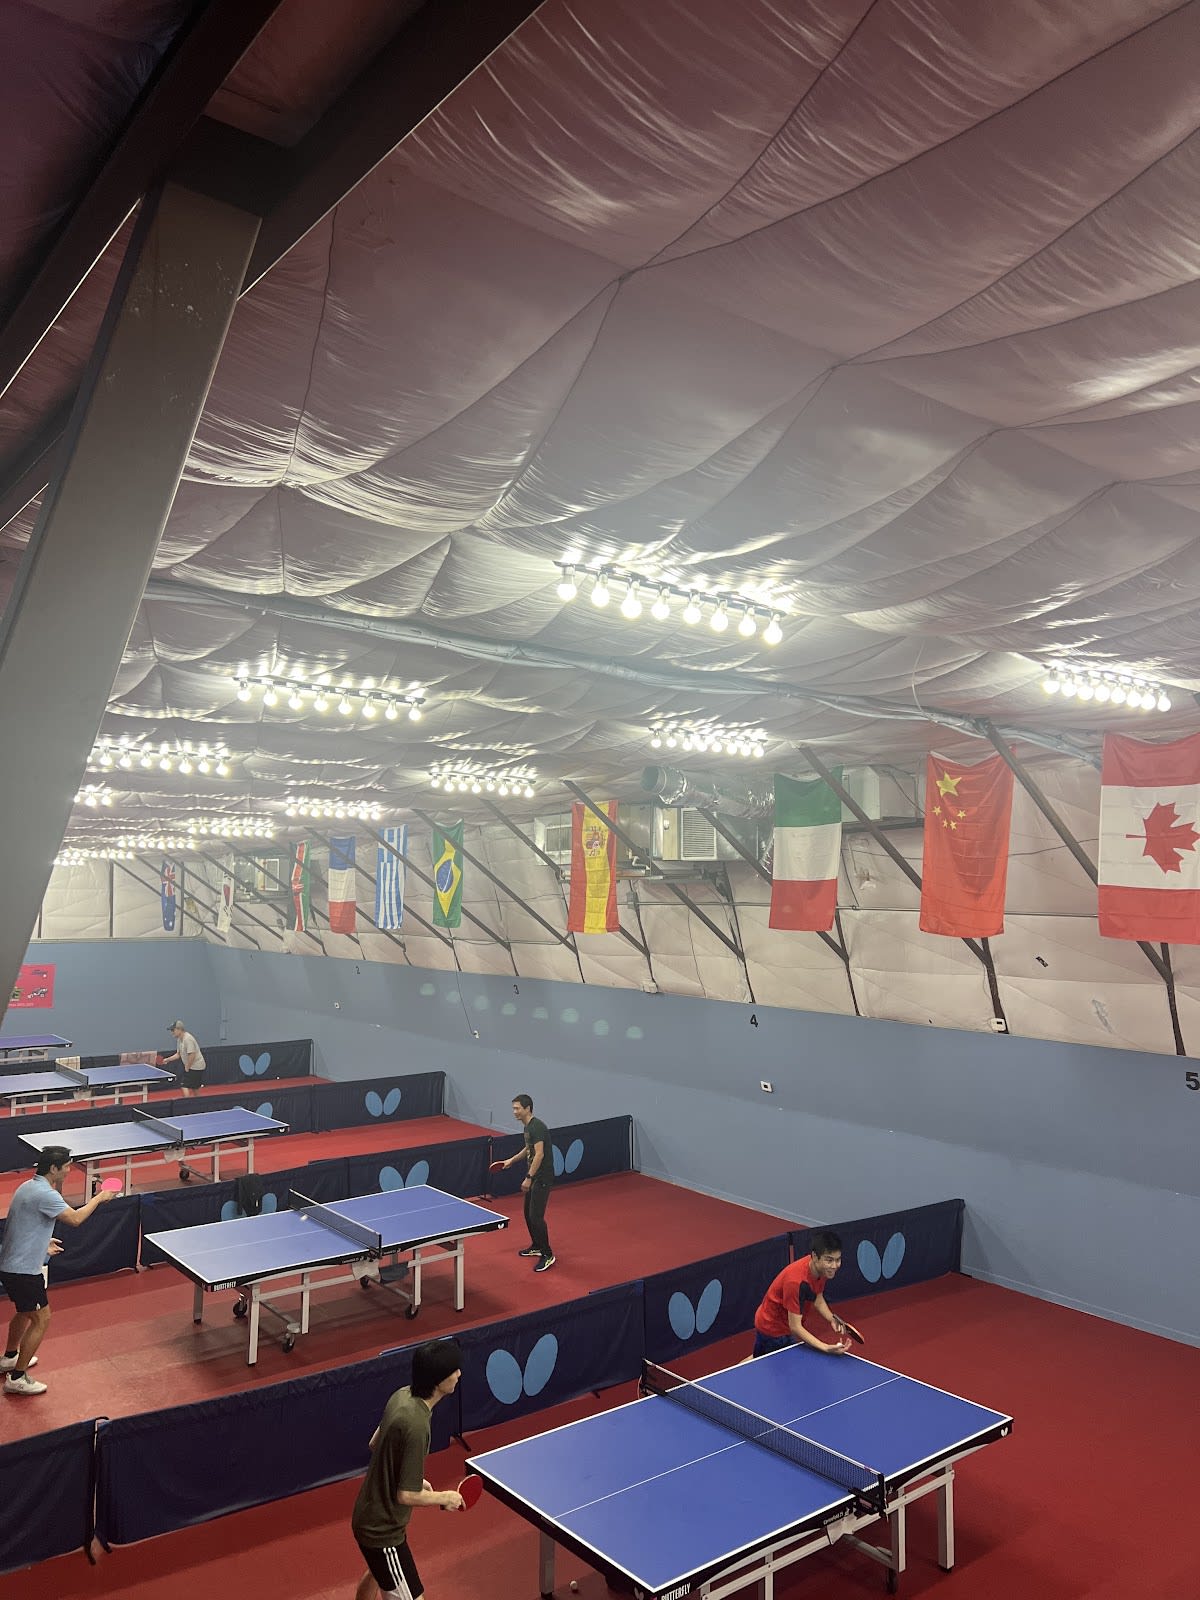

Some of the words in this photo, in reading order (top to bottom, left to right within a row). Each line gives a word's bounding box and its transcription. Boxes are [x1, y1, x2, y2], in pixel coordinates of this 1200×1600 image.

[750, 1014, 759, 1028] 4
[1185, 1071, 1200, 1091] 5
[213, 1281, 237, 1291] BUTTERFLY
